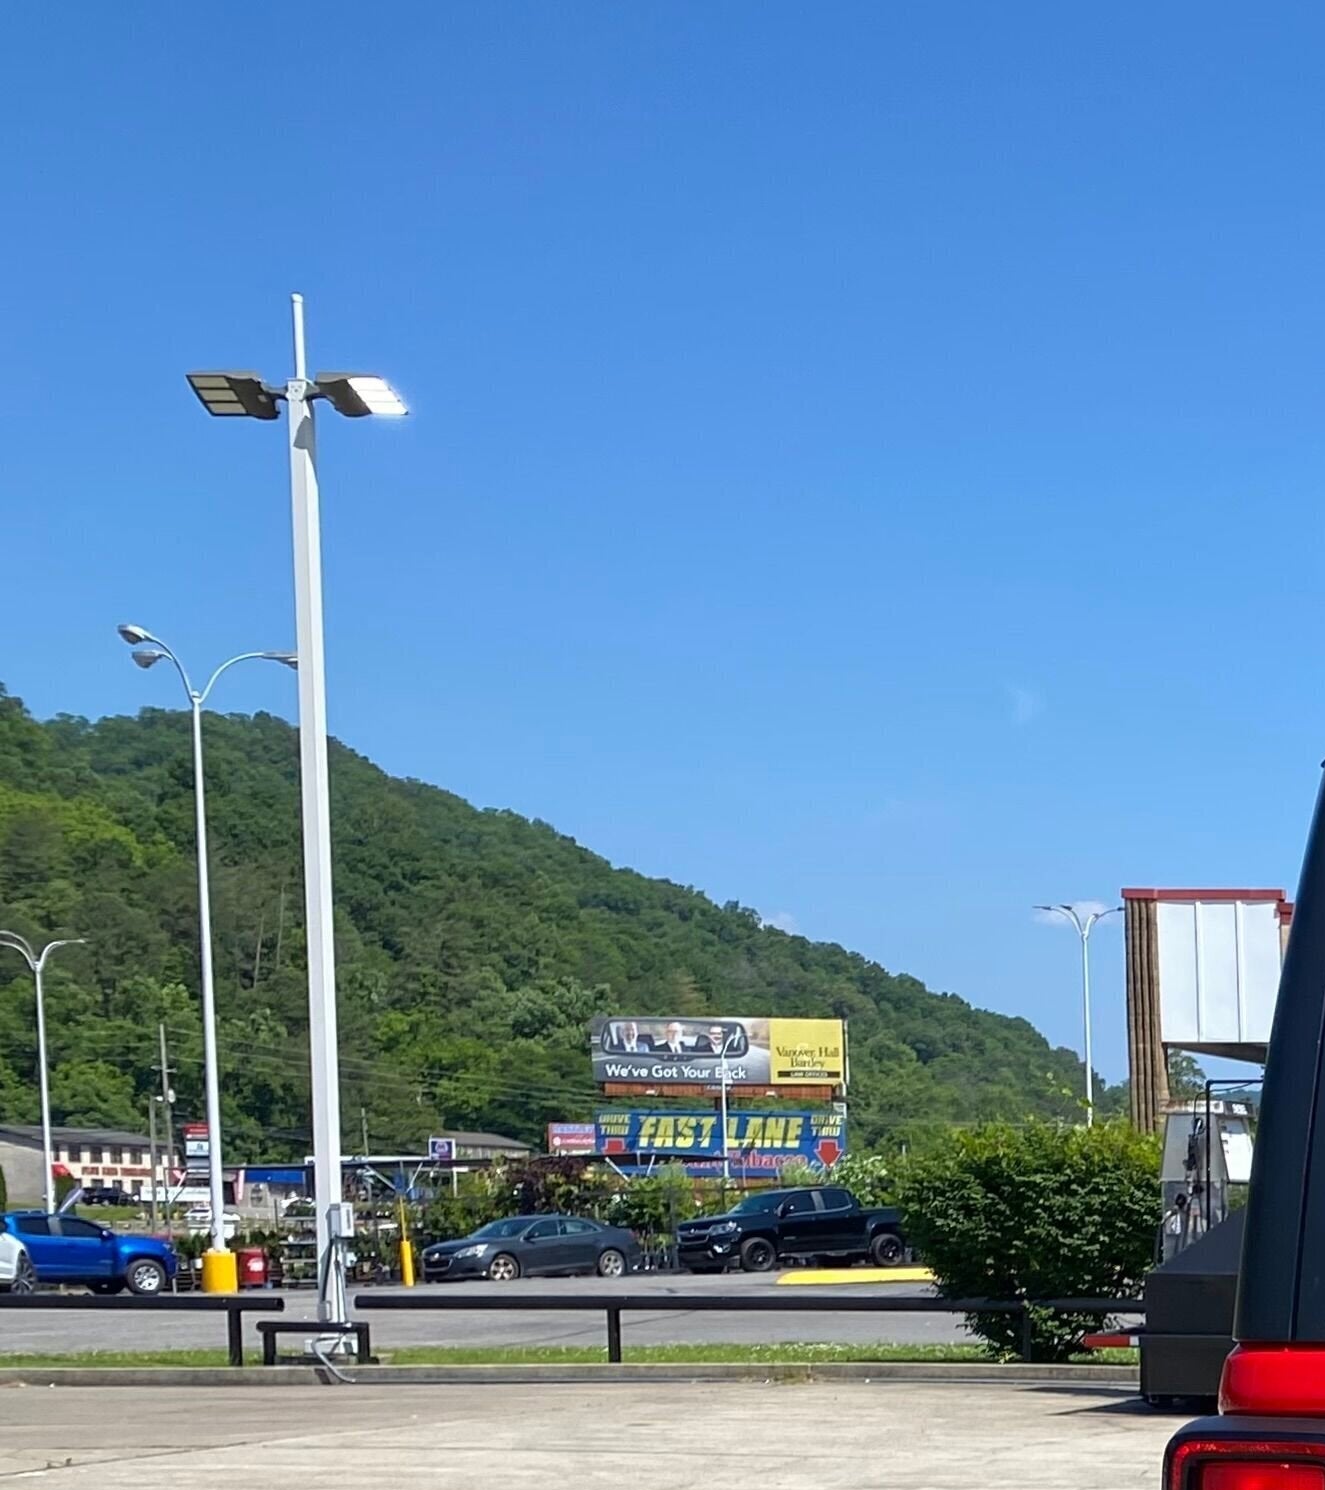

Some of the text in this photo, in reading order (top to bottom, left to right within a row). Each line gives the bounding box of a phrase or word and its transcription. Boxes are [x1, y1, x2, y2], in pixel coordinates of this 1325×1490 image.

[605, 1064, 649, 1077] We've
[652, 1065, 678, 1078] Got
[681, 1065, 711, 1079] Your
[811, 1115, 843, 1125] DRIVE
[638, 1115, 804, 1149] FAST LANE
